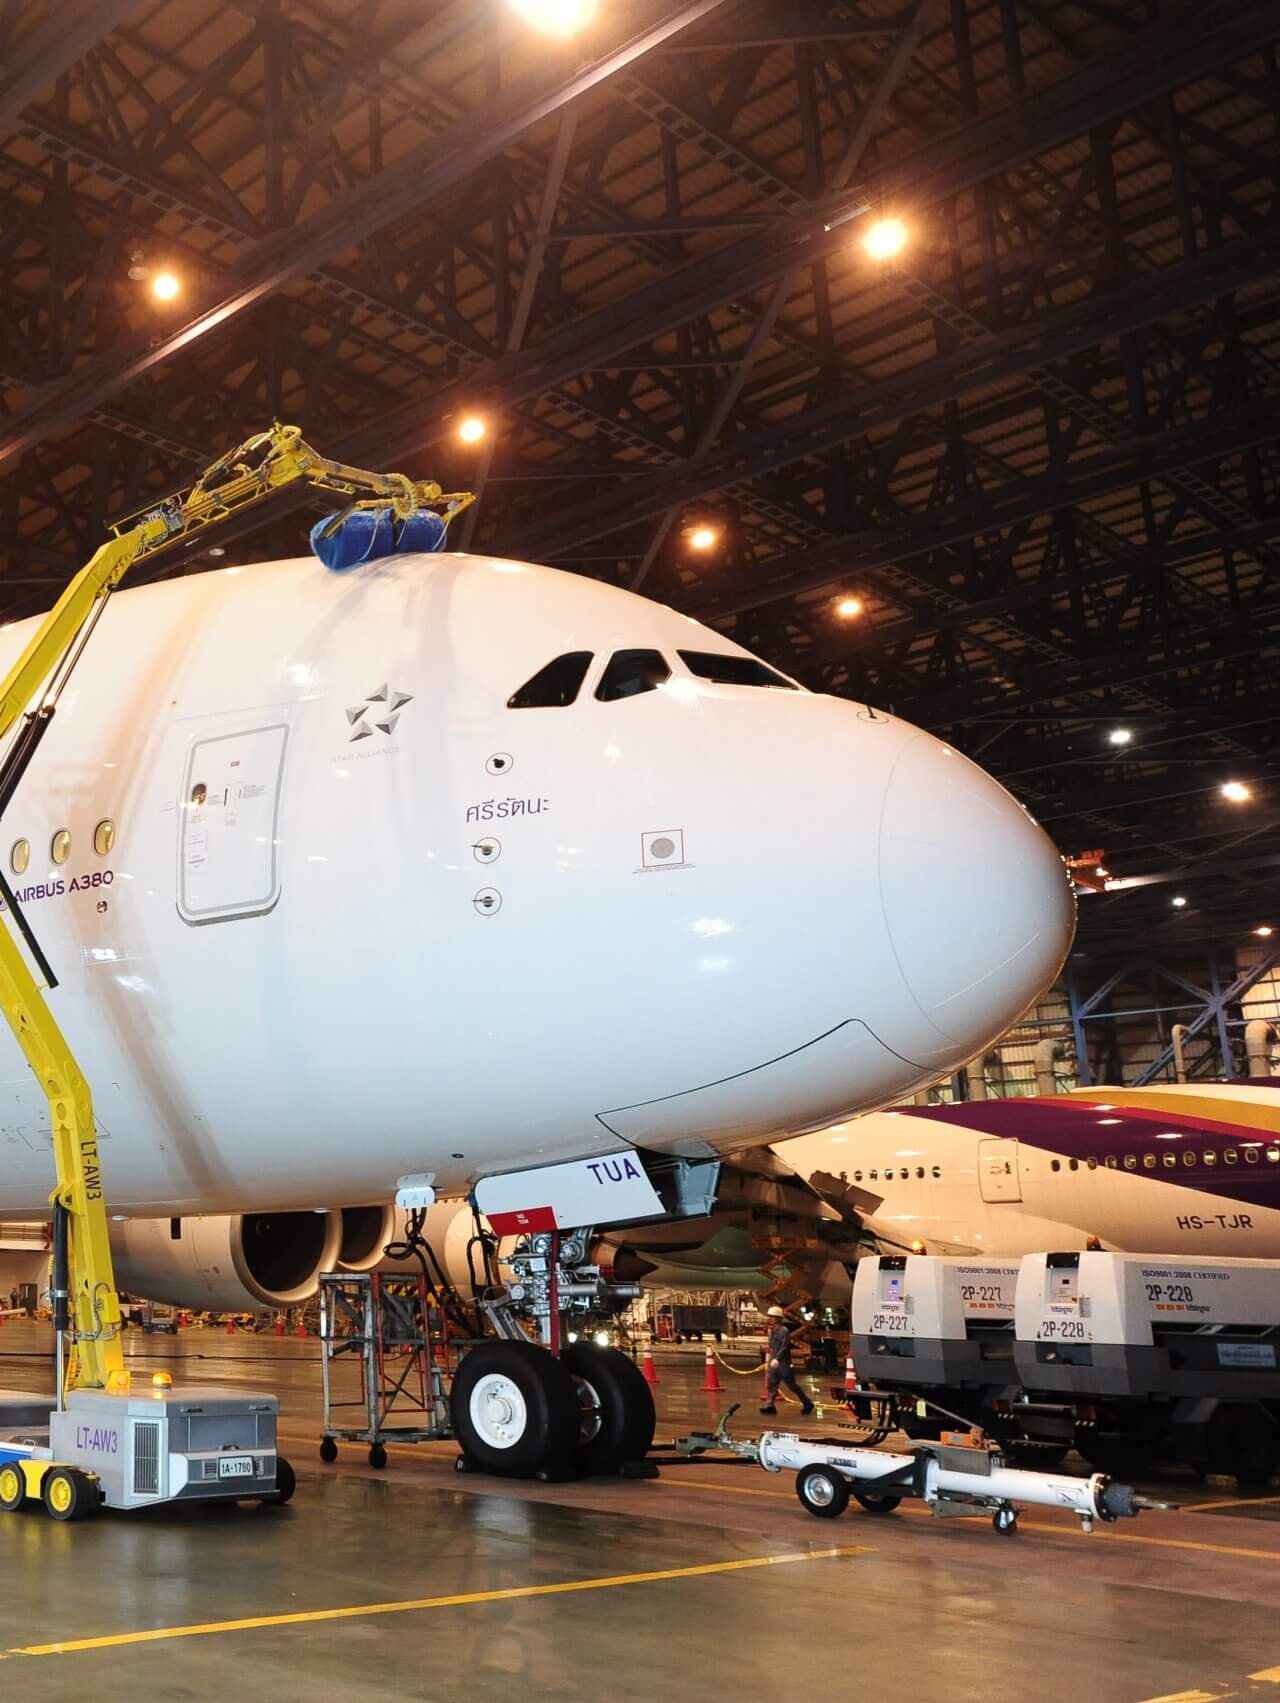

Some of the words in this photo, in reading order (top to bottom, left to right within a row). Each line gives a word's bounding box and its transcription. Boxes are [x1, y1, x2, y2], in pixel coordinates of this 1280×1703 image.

[466, 797, 549, 823] ศรีรัตนะ
[13, 880, 65, 903] AIRBUS
[68, 870, 114, 893] A380
[80, 1140, 102, 1201] LT-AW3
[586, 1158, 641, 1185] TUA
[1176, 1214, 1254, 1230] HS-TJR
[960, 1285, 1002, 1302] 2P-227
[1145, 1284, 1193, 1303] 2P-228
[873, 1314, 908, 1331] 2P-227
[1042, 1320, 1085, 1338] 2P-228
[76, 1426, 118, 1455] LT-AW3
